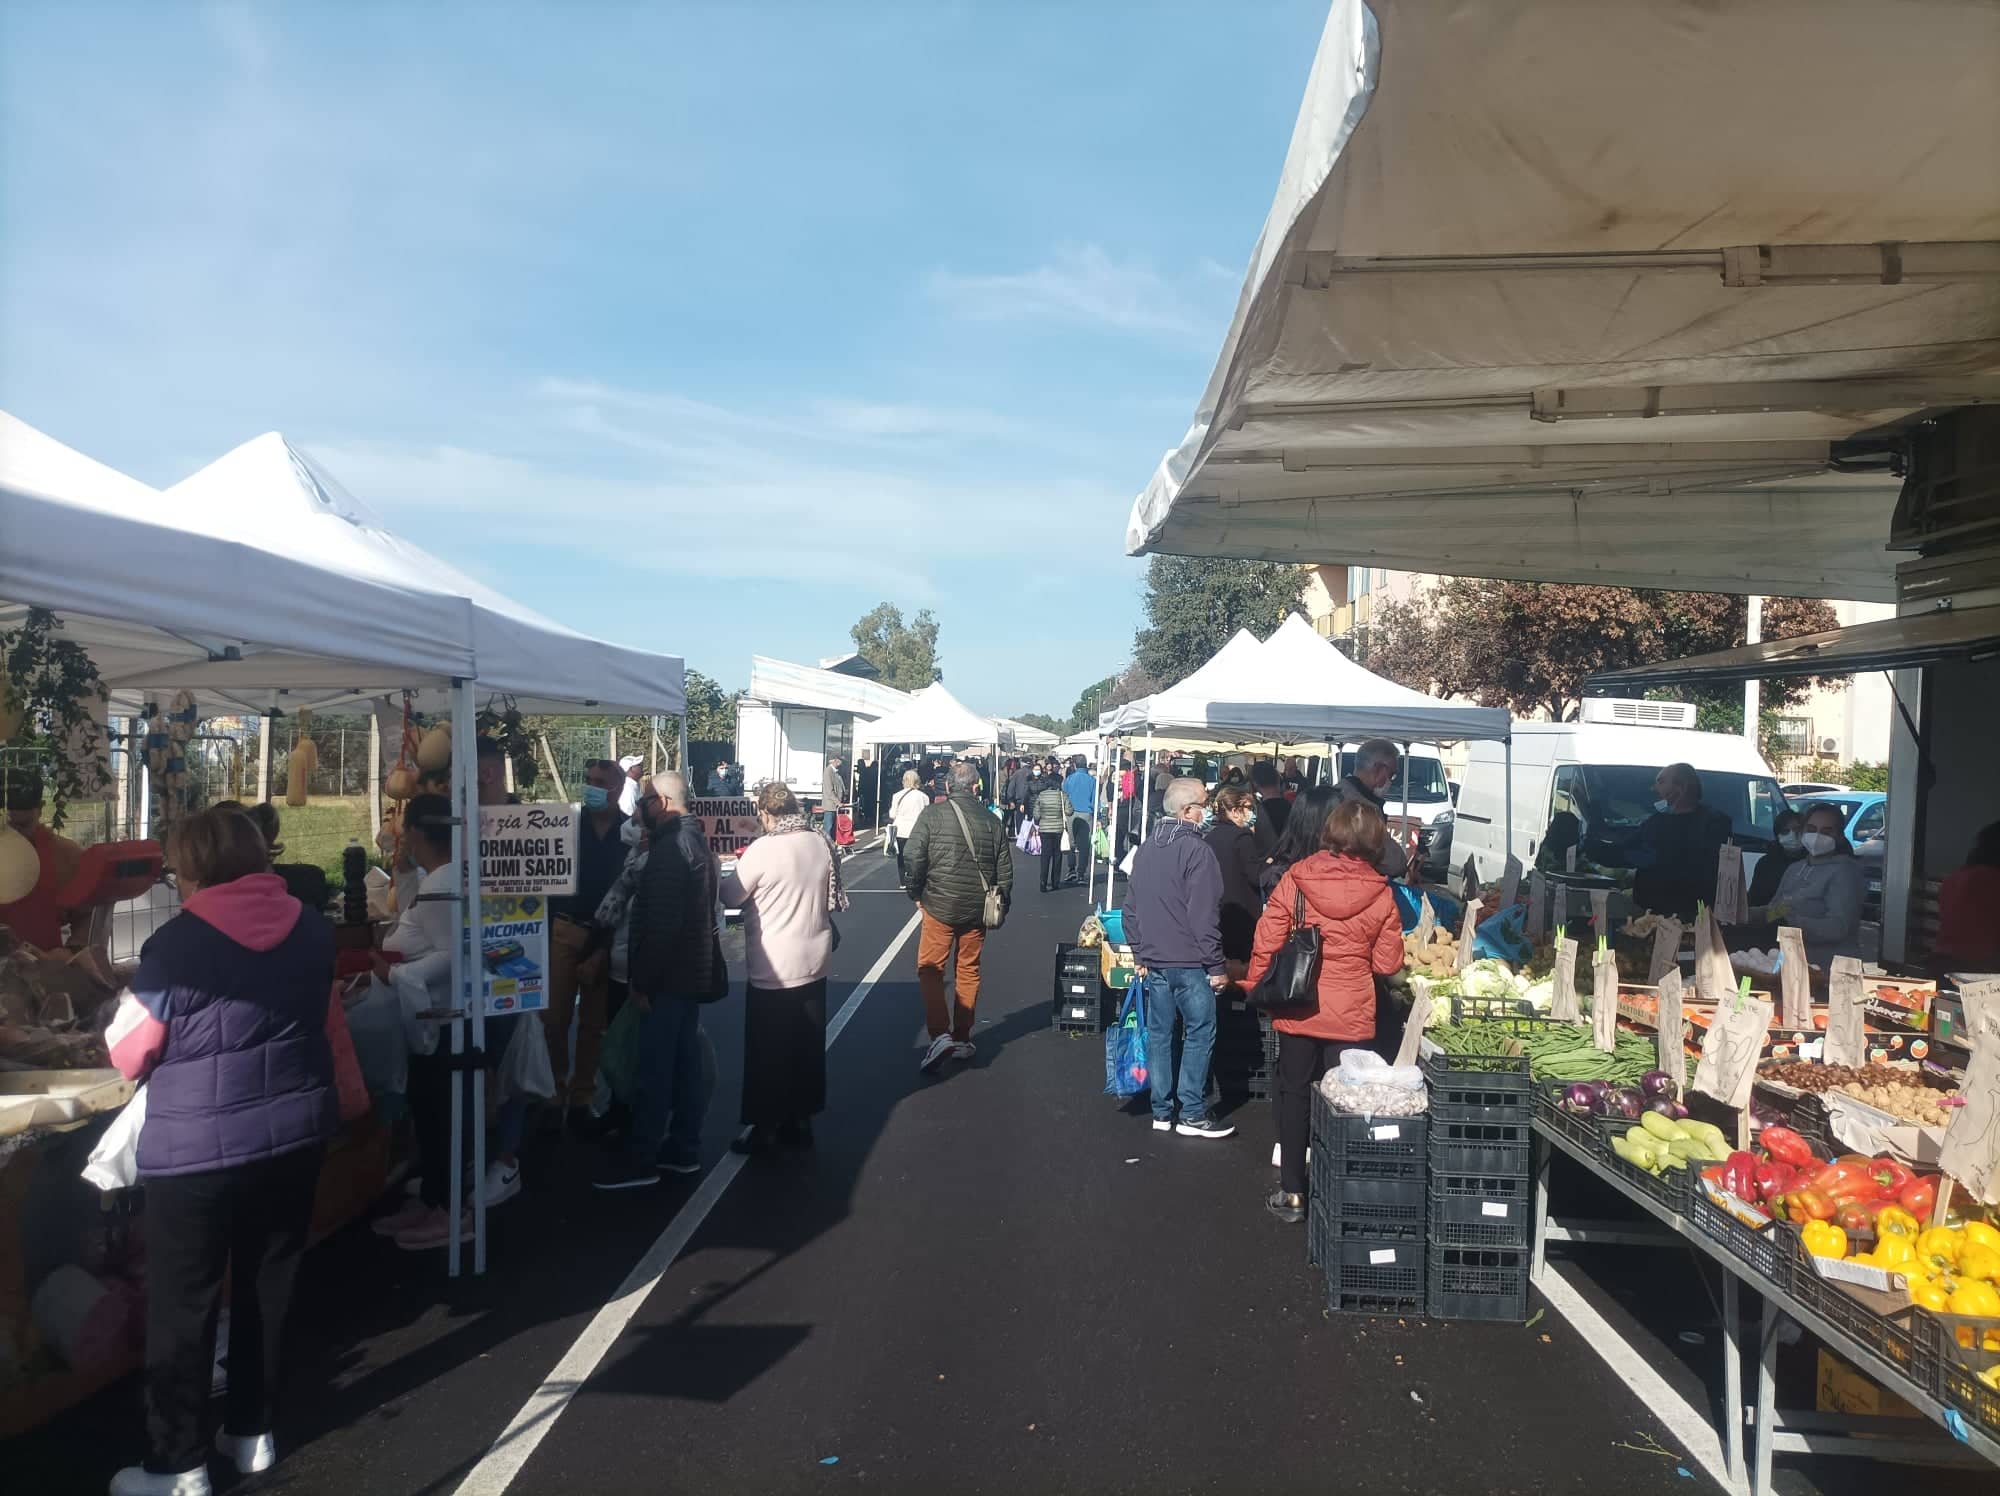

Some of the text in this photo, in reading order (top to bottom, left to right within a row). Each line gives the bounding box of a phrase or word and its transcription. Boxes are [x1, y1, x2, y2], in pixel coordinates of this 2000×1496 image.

[688, 801, 758, 816] FORMAGGIO
[527, 809, 570, 830] Rosa
[714, 818, 735, 834] AL
[478, 838, 563, 858] ORMAGGI E
[525, 858, 572, 876] SARDI
